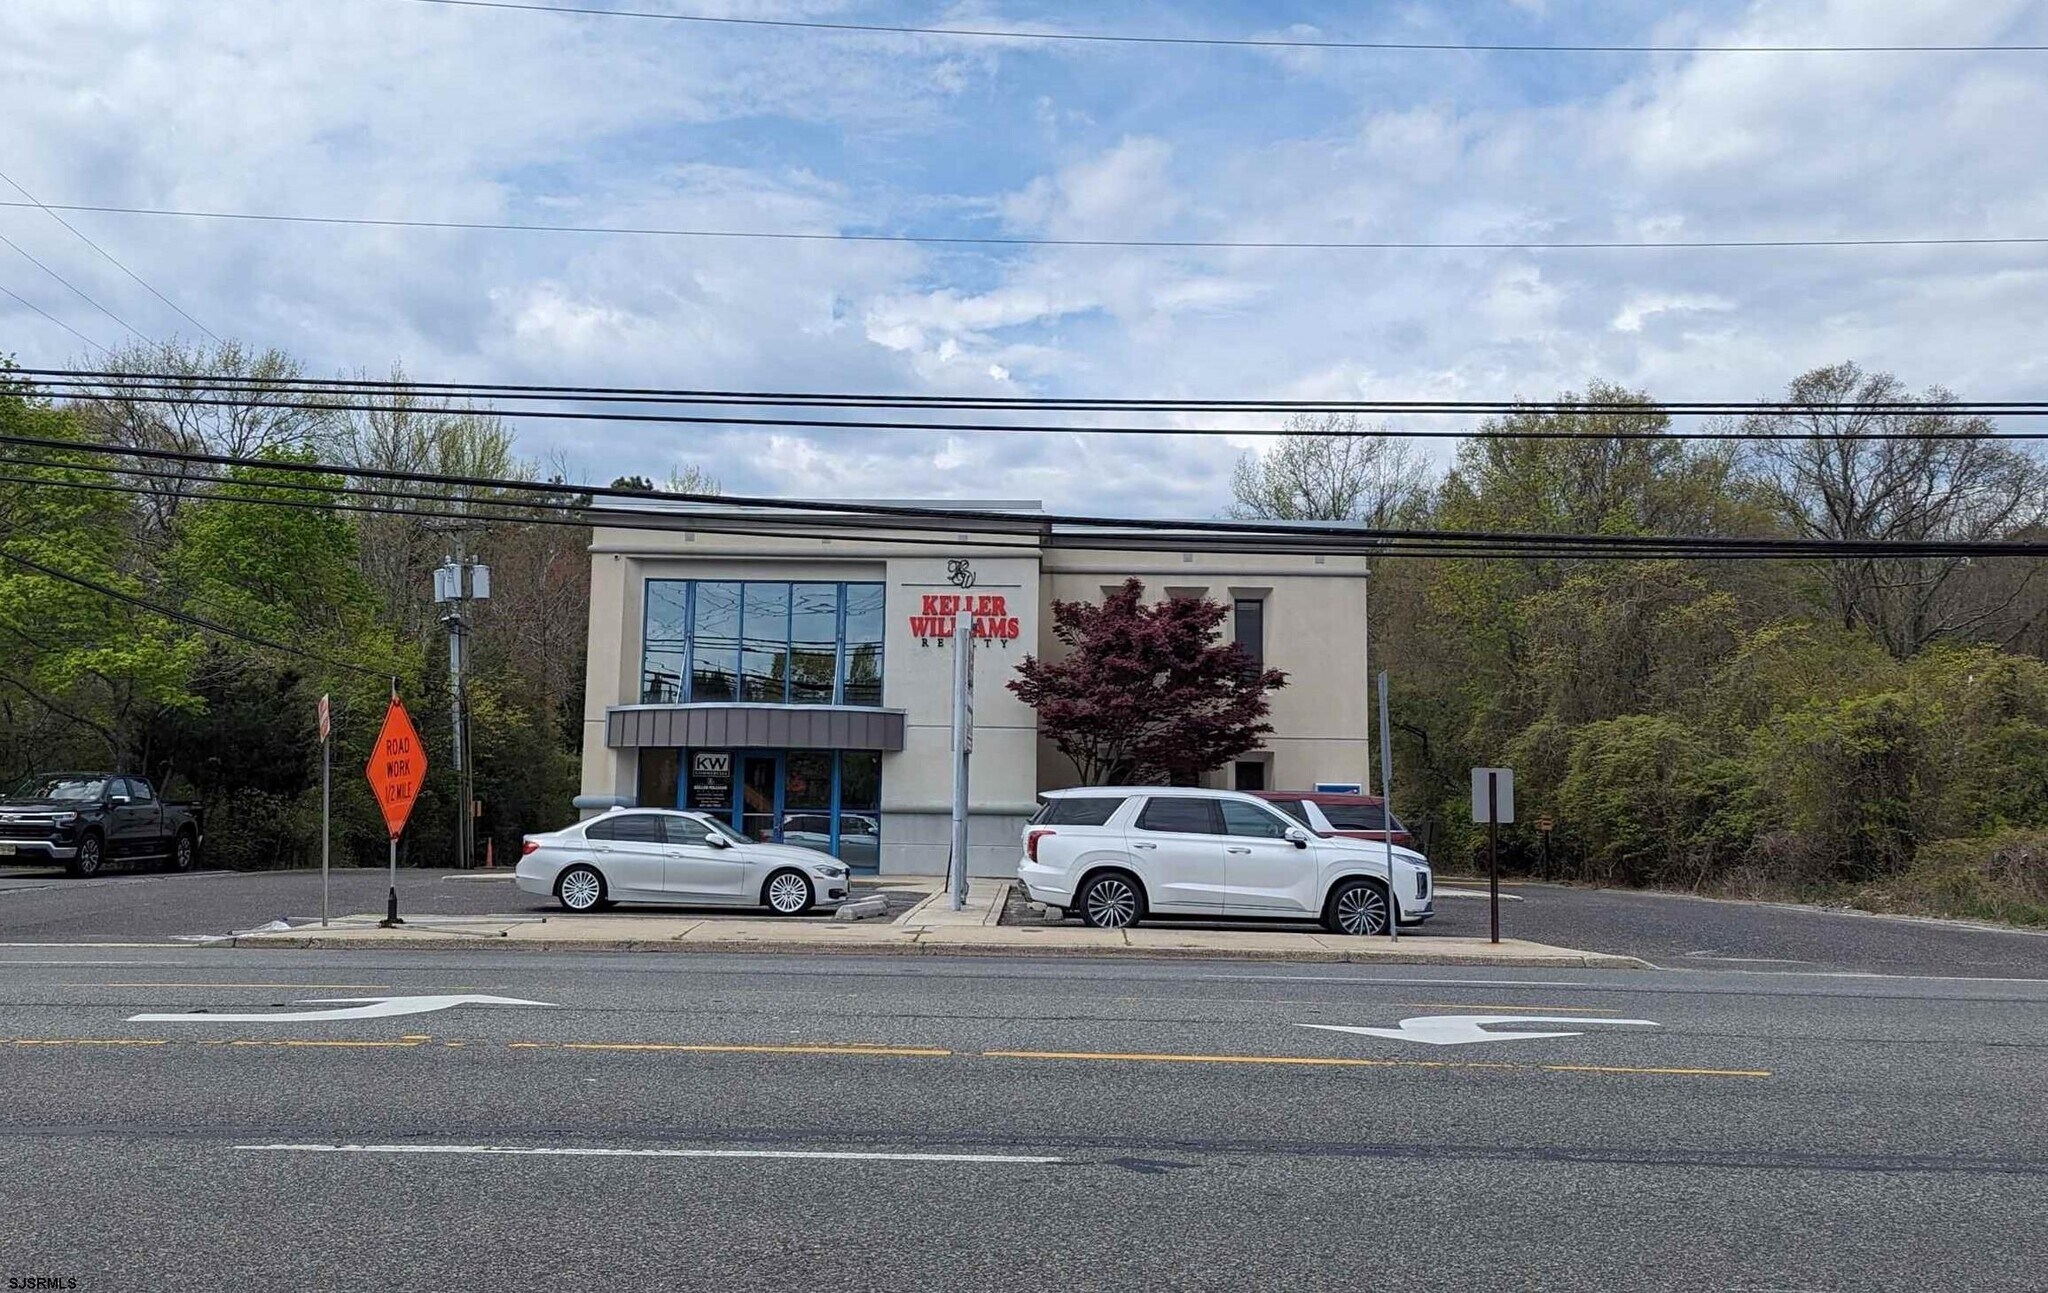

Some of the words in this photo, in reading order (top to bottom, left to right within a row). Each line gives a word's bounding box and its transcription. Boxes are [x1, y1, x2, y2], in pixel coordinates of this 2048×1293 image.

[921, 595, 1006, 616] KELLER
[909, 616, 1020, 639] WILAMS
[921, 639, 1009, 648] RETY
[386, 737, 410, 756] ROAD
[386, 759, 411, 779] WORK
[696, 757, 727, 770] KW
[397, 781, 412, 800] MILE
